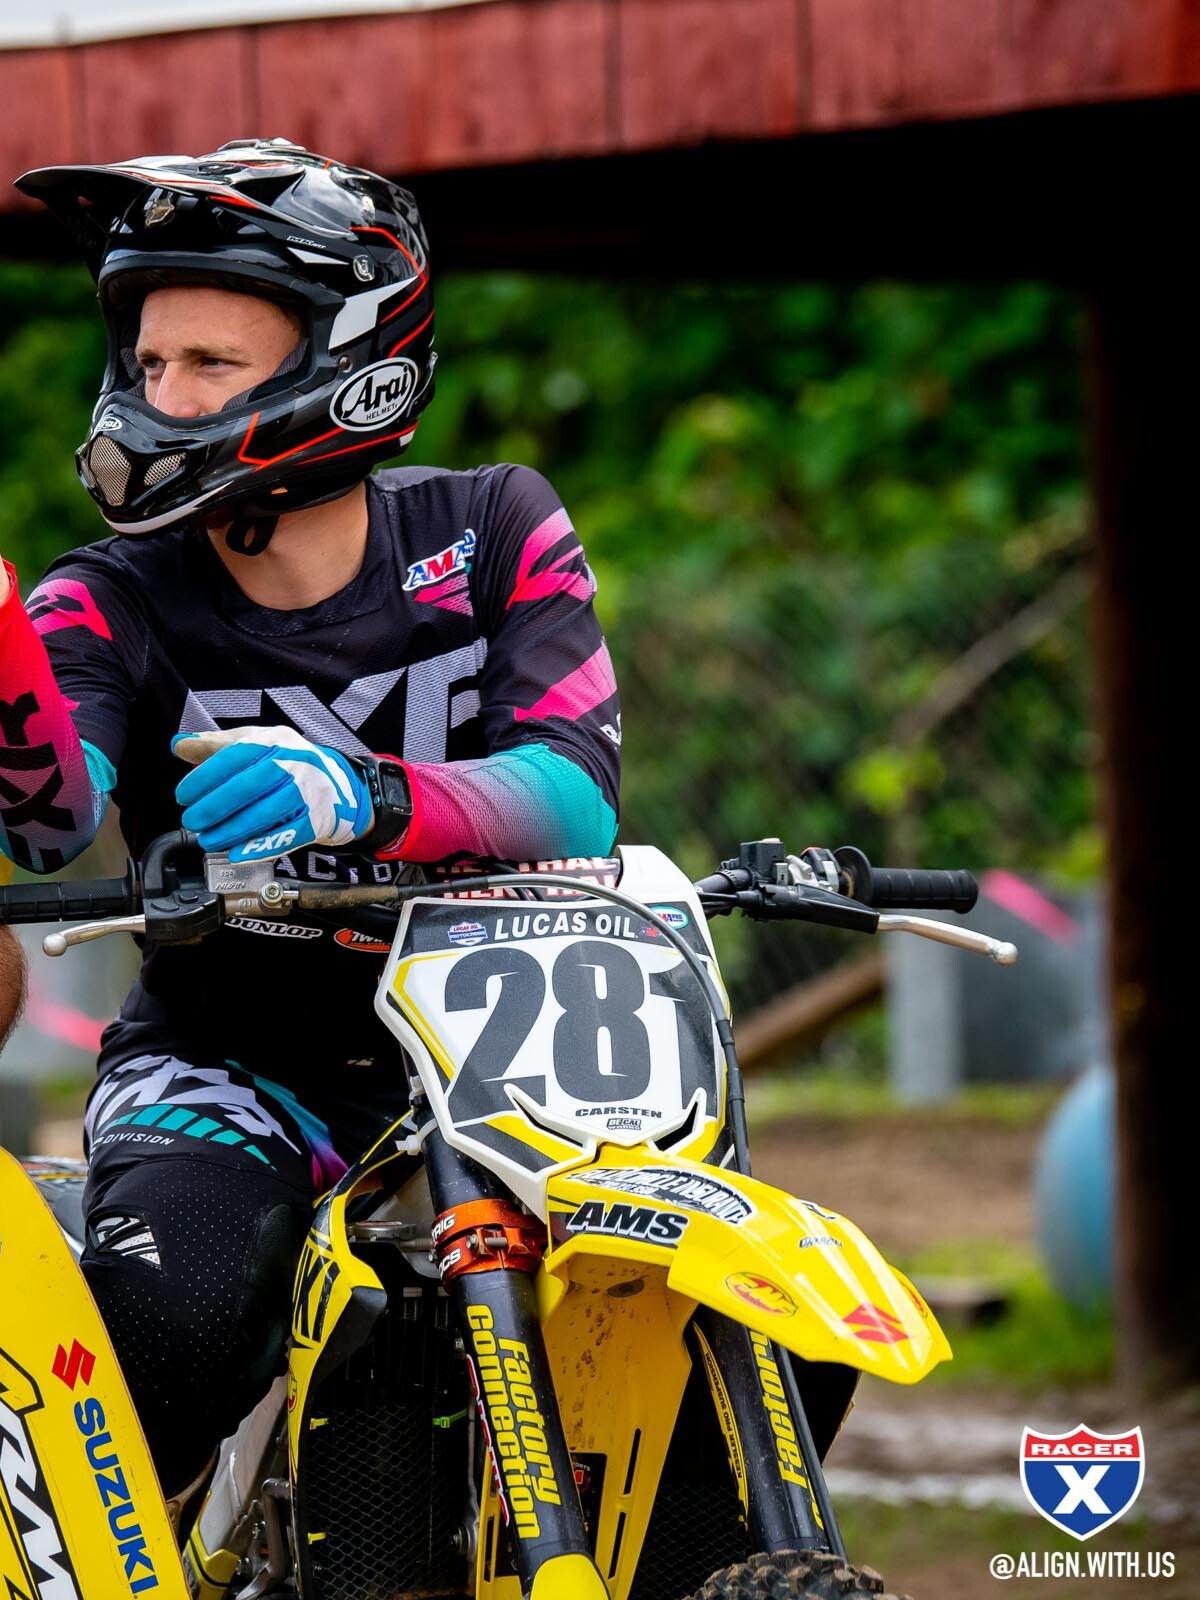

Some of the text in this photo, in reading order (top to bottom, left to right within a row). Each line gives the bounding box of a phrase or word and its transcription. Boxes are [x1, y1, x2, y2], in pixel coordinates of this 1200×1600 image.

[342, 363, 409, 419] Arai
[242, 829, 296, 856] FXR
[227, 918, 321, 938] DUNLOP
[494, 912, 636, 940] LUCAS OIL
[445, 939, 718, 1123] 281
[575, 1107, 662, 1118] CARSTEN
[103, 1133, 175, 1146] DIVISION
[569, 1202, 689, 1240] AMS
[498, 1338, 561, 1505] Factory
[723, 1411, 733, 1432] PRO
[729, 1431, 743, 1478] KESSLER
[73, 1397, 159, 1594] SUZUKI
